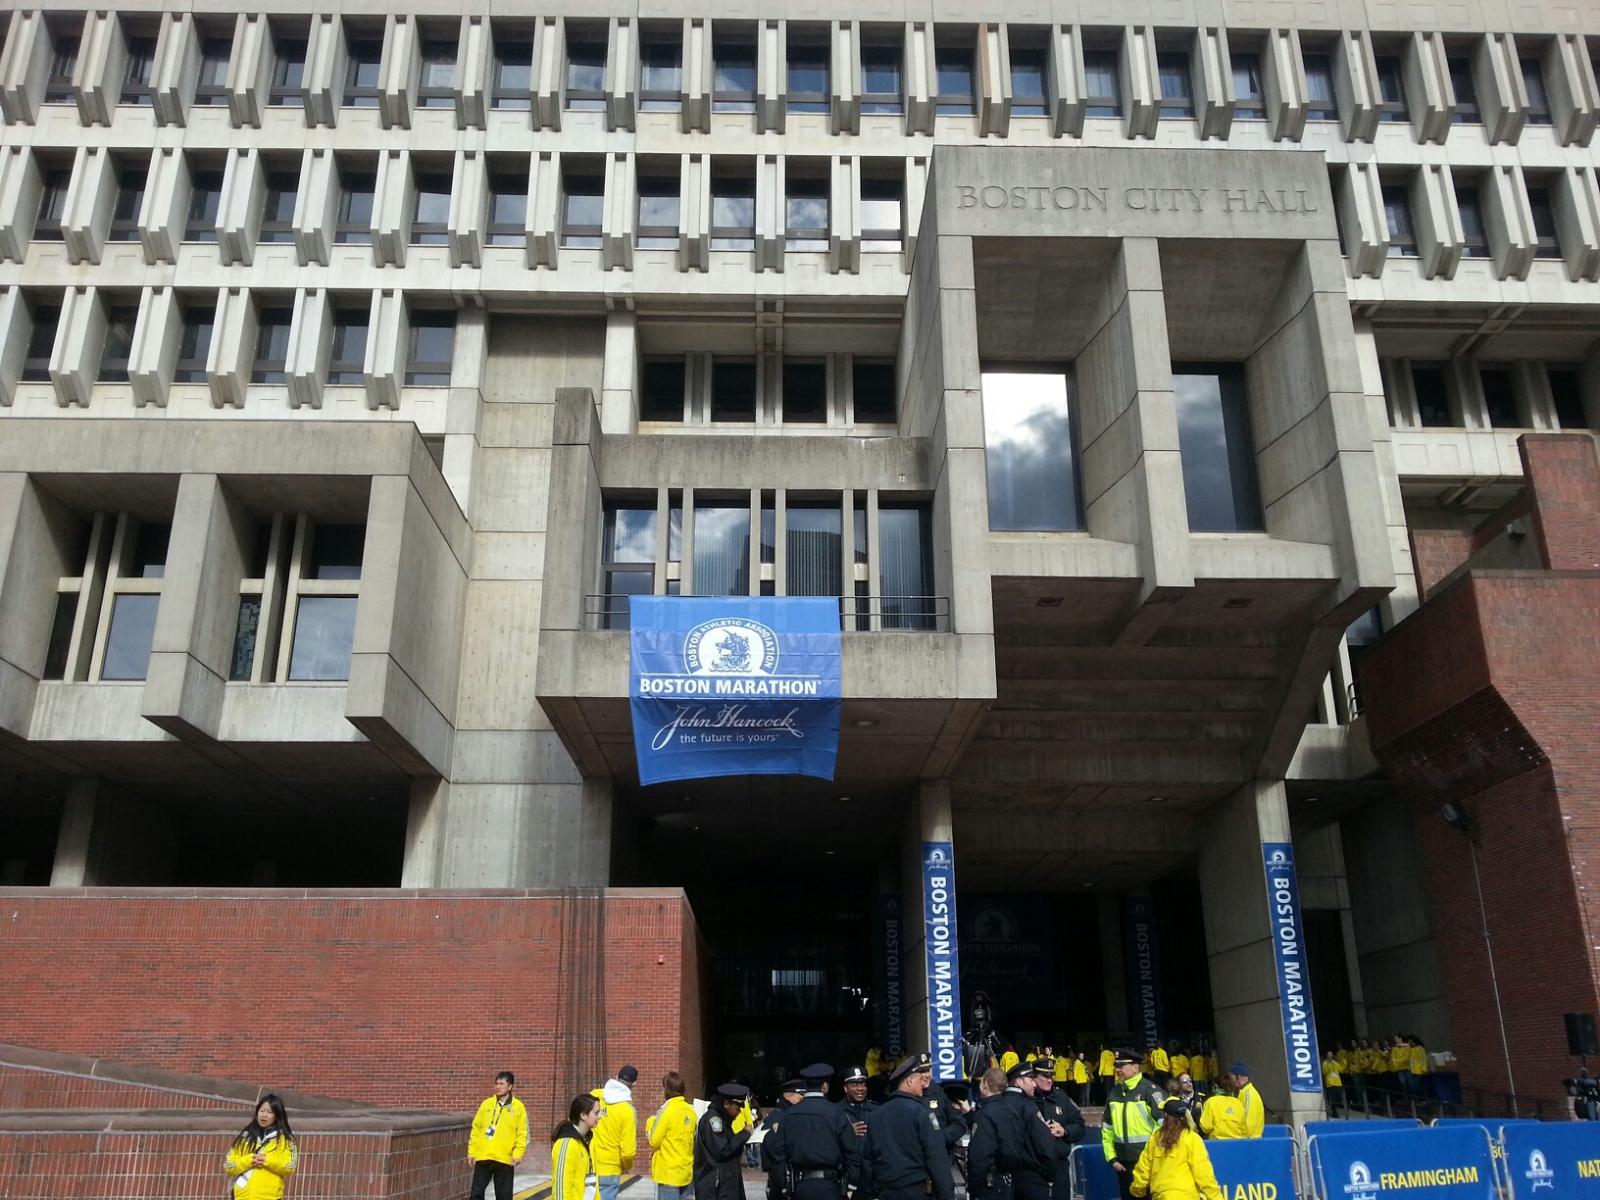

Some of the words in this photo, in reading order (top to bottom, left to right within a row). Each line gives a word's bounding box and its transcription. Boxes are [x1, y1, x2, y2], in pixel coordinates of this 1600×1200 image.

[955, 185, 1112, 212] BOSTON
[1123, 187, 1209, 213] CITY
[1221, 188, 1318, 213] HALL
[687, 631, 702, 668] BOSTON
[700, 620, 742, 632] ATHLETIC
[744, 622, 777, 669] ASSOCIATION
[640, 678, 710, 694] BOSTON
[716, 679, 817, 695] MARATHON
[652, 704, 712, 750] John
[711, 703, 804, 738] Hancock
[680, 734, 697, 744] the
[701, 732, 733, 743] future
[736, 733, 745, 742] is
[747, 734, 776, 744] yours
[930, 876, 950, 955] BOSTON
[1273, 877, 1298, 955] BOSTON
[885, 919, 899, 977] BOSTON
[1135, 922, 1152, 980] BOSTON
[887, 981, 901, 1059] MARATHO
[934, 961, 956, 1080] MARATHON
[1140, 984, 1158, 1048] MARATH
[1283, 961, 1313, 1079] MARATHON
[1380, 1166, 1479, 1190] FRAMINGHAM
